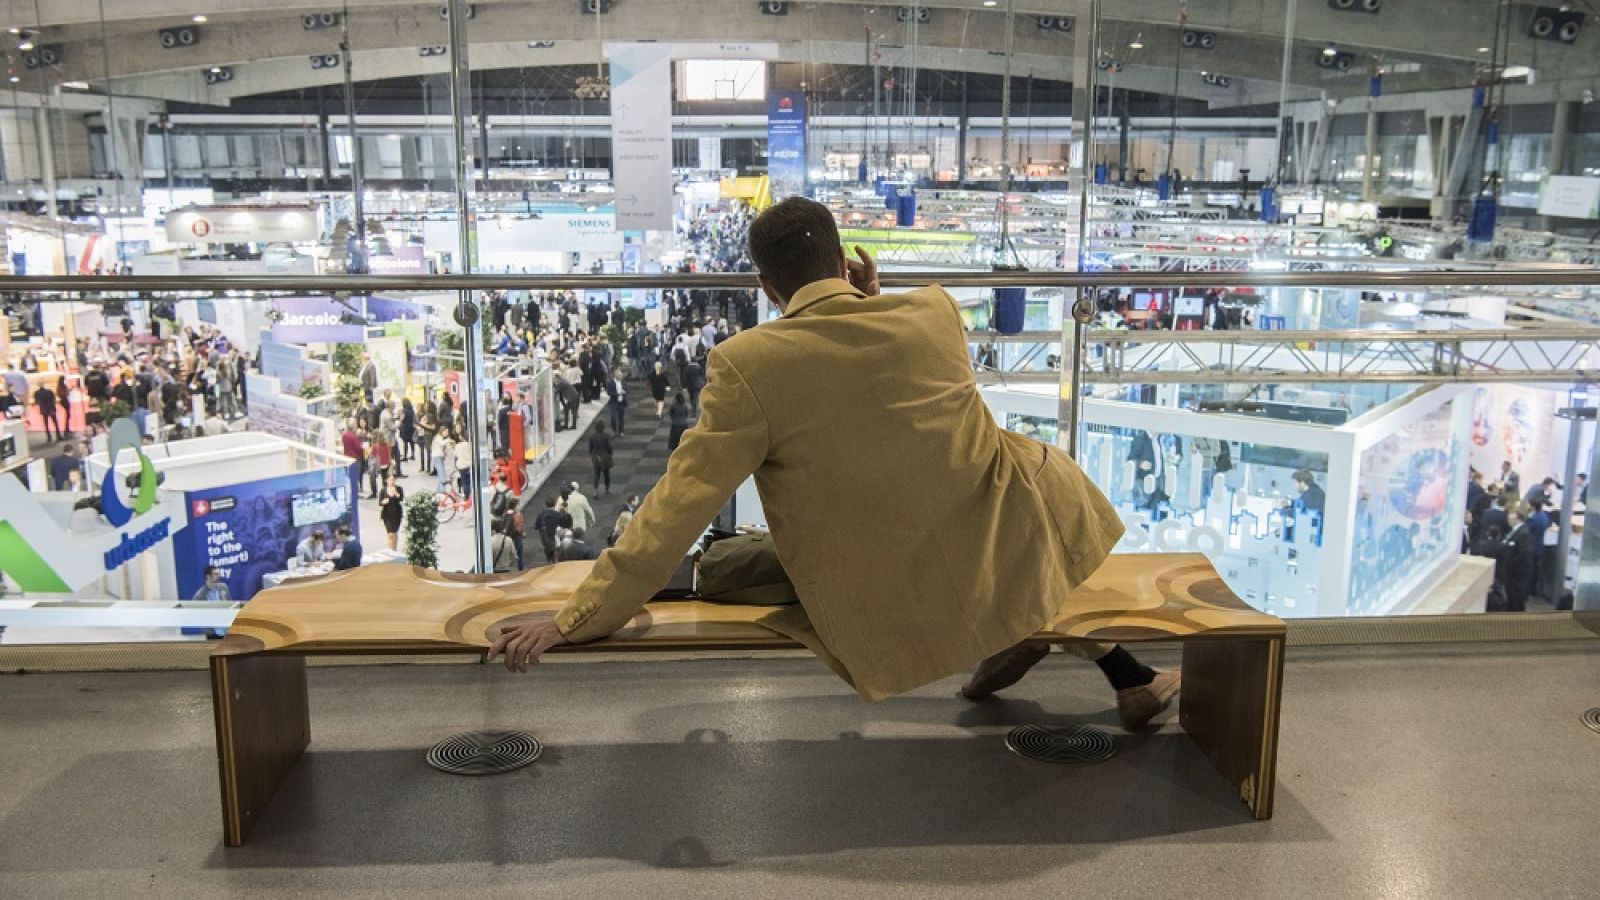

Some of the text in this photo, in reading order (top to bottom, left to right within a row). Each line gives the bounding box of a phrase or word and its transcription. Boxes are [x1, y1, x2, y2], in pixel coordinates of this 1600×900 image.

[567, 219, 610, 228] SIEMENS
[206, 521, 228, 533] The
[207, 530, 234, 545] right
[208, 542, 242, 557] to the
